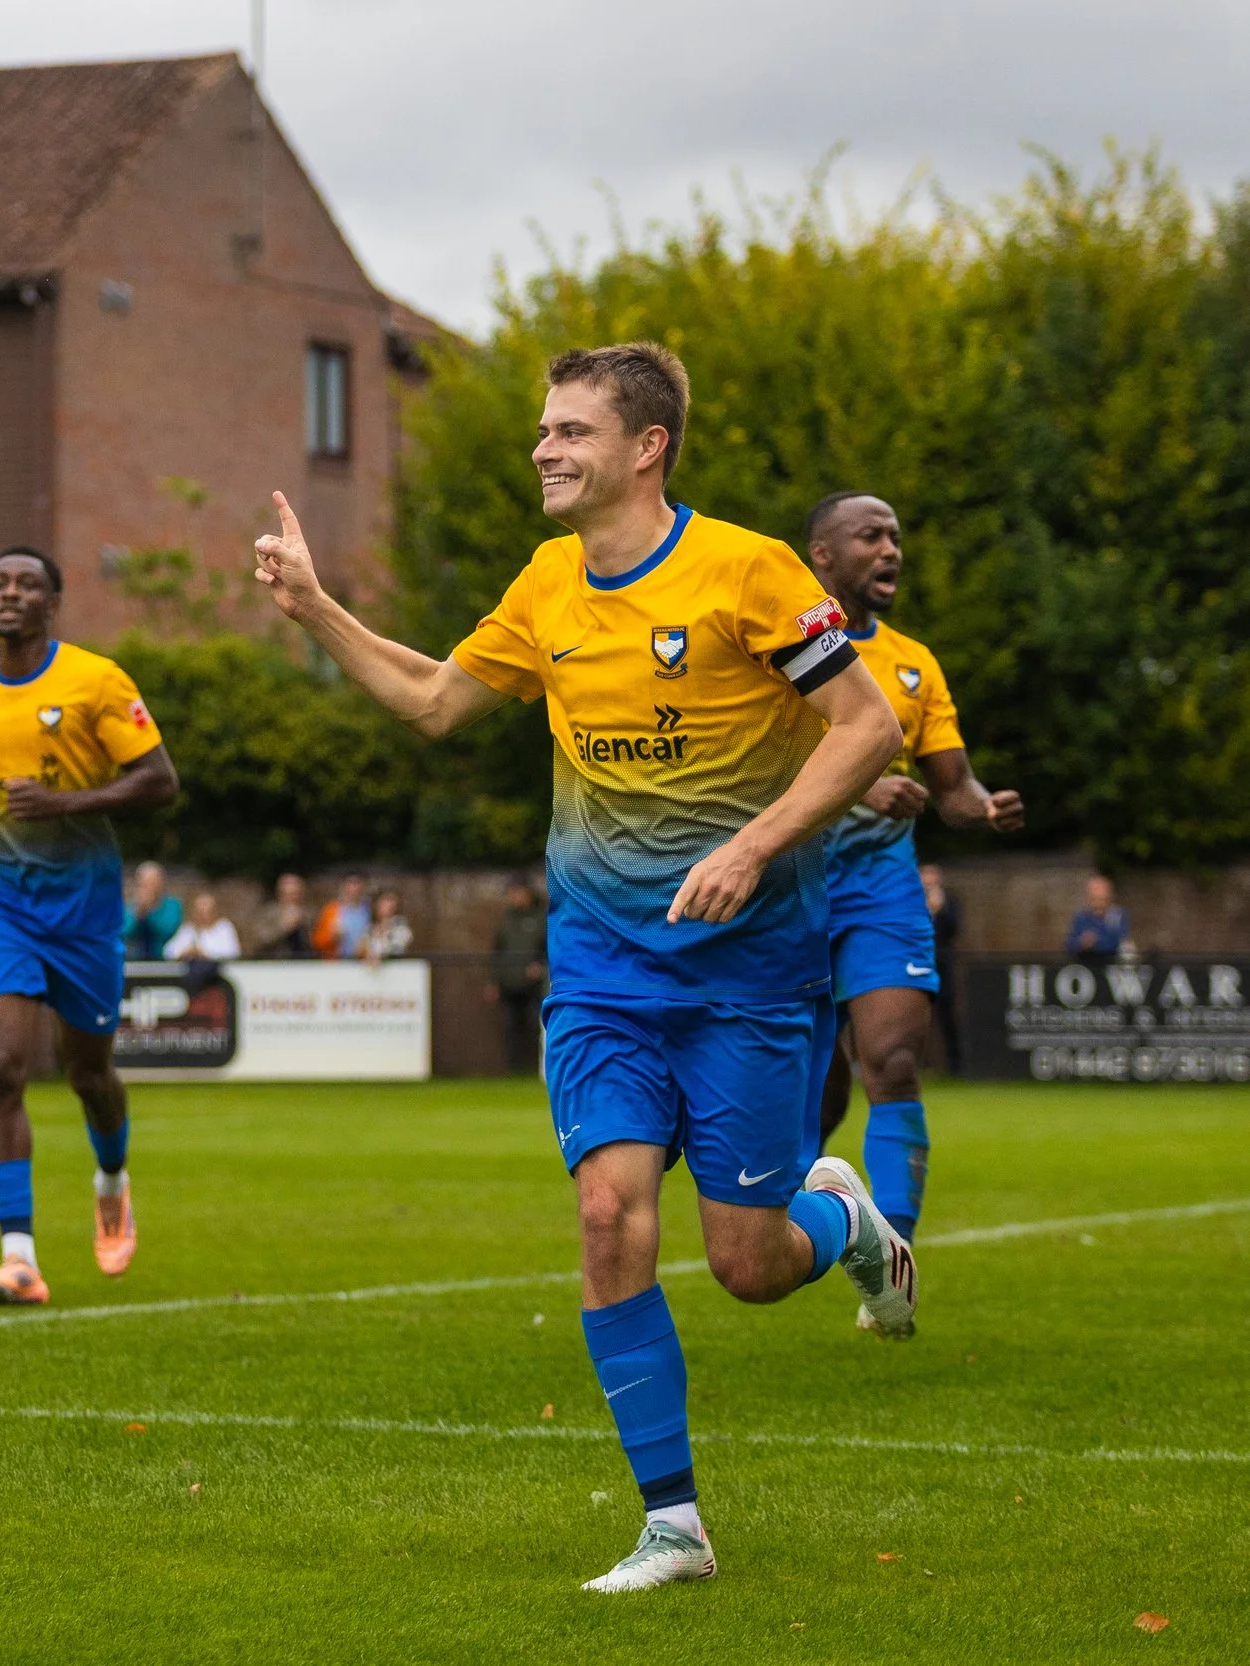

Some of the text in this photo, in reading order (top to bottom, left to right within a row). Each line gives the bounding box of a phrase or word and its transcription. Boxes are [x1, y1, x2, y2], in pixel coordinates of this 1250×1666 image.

[802, 602, 834, 628] PITCHING
[820, 616, 831, 629] IN
[573, 732, 688, 762] Glencar
[1008, 964, 1246, 1007] HOWAR
